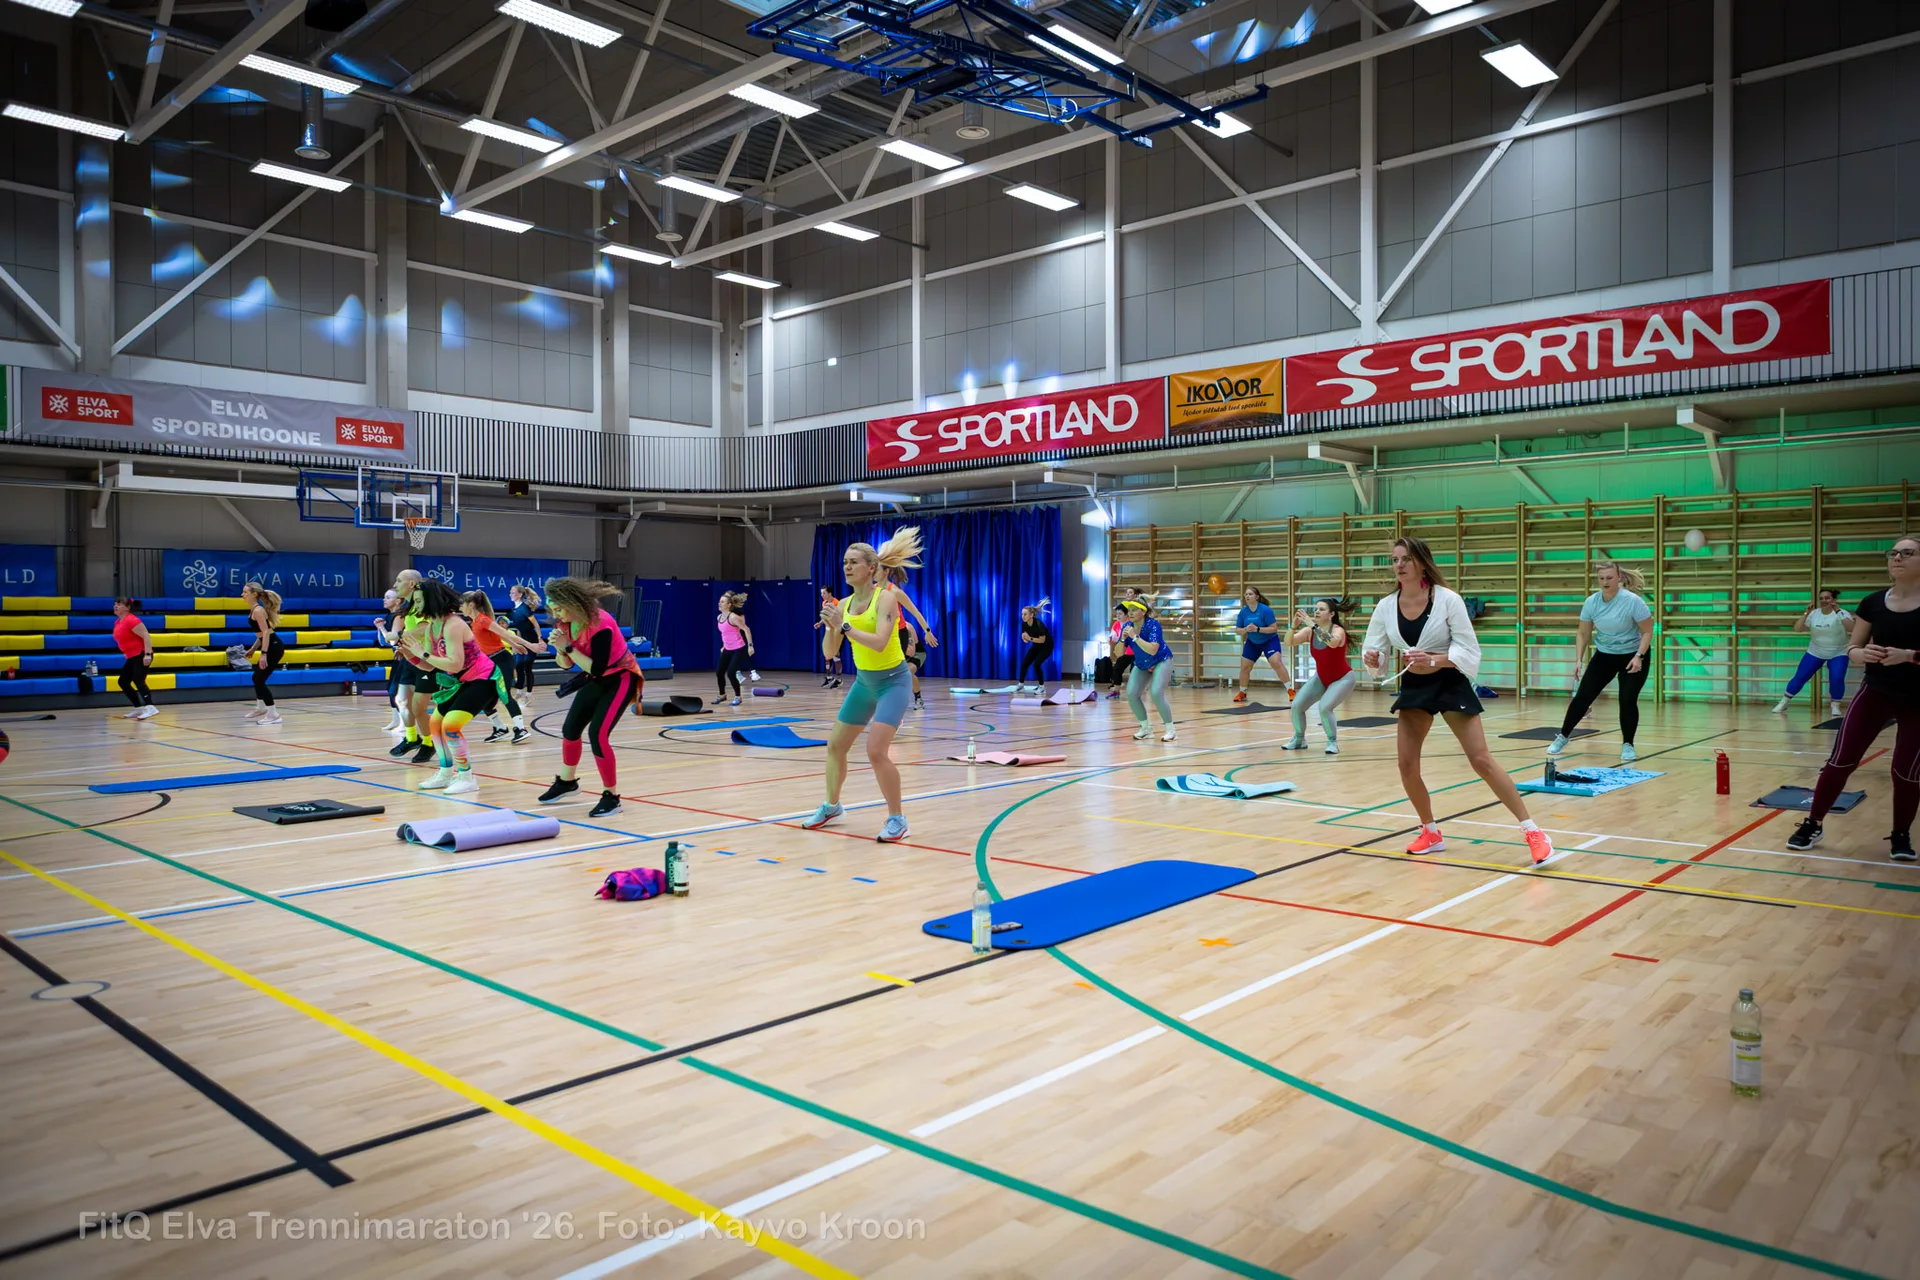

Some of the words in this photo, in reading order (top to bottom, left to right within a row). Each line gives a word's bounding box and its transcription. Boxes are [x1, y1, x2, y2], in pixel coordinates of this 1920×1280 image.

[1410, 300, 1780, 391] SPORTLAND
[1187, 376, 1262, 404] IKODOR
[77, 396, 109, 408] ELVA
[211, 400, 268, 420] ELVA
[77, 406, 119, 419] SPORT
[152, 417, 322, 447] SPORDIHOONE
[362, 425, 386, 435] ELVA
[938, 394, 1139, 453] SPORTLAND
[362, 433, 394, 444] SPORT
[230, 568, 282, 586] ELVA
[293, 573, 345, 588] VALD
[465, 573, 507, 589] ELVA
